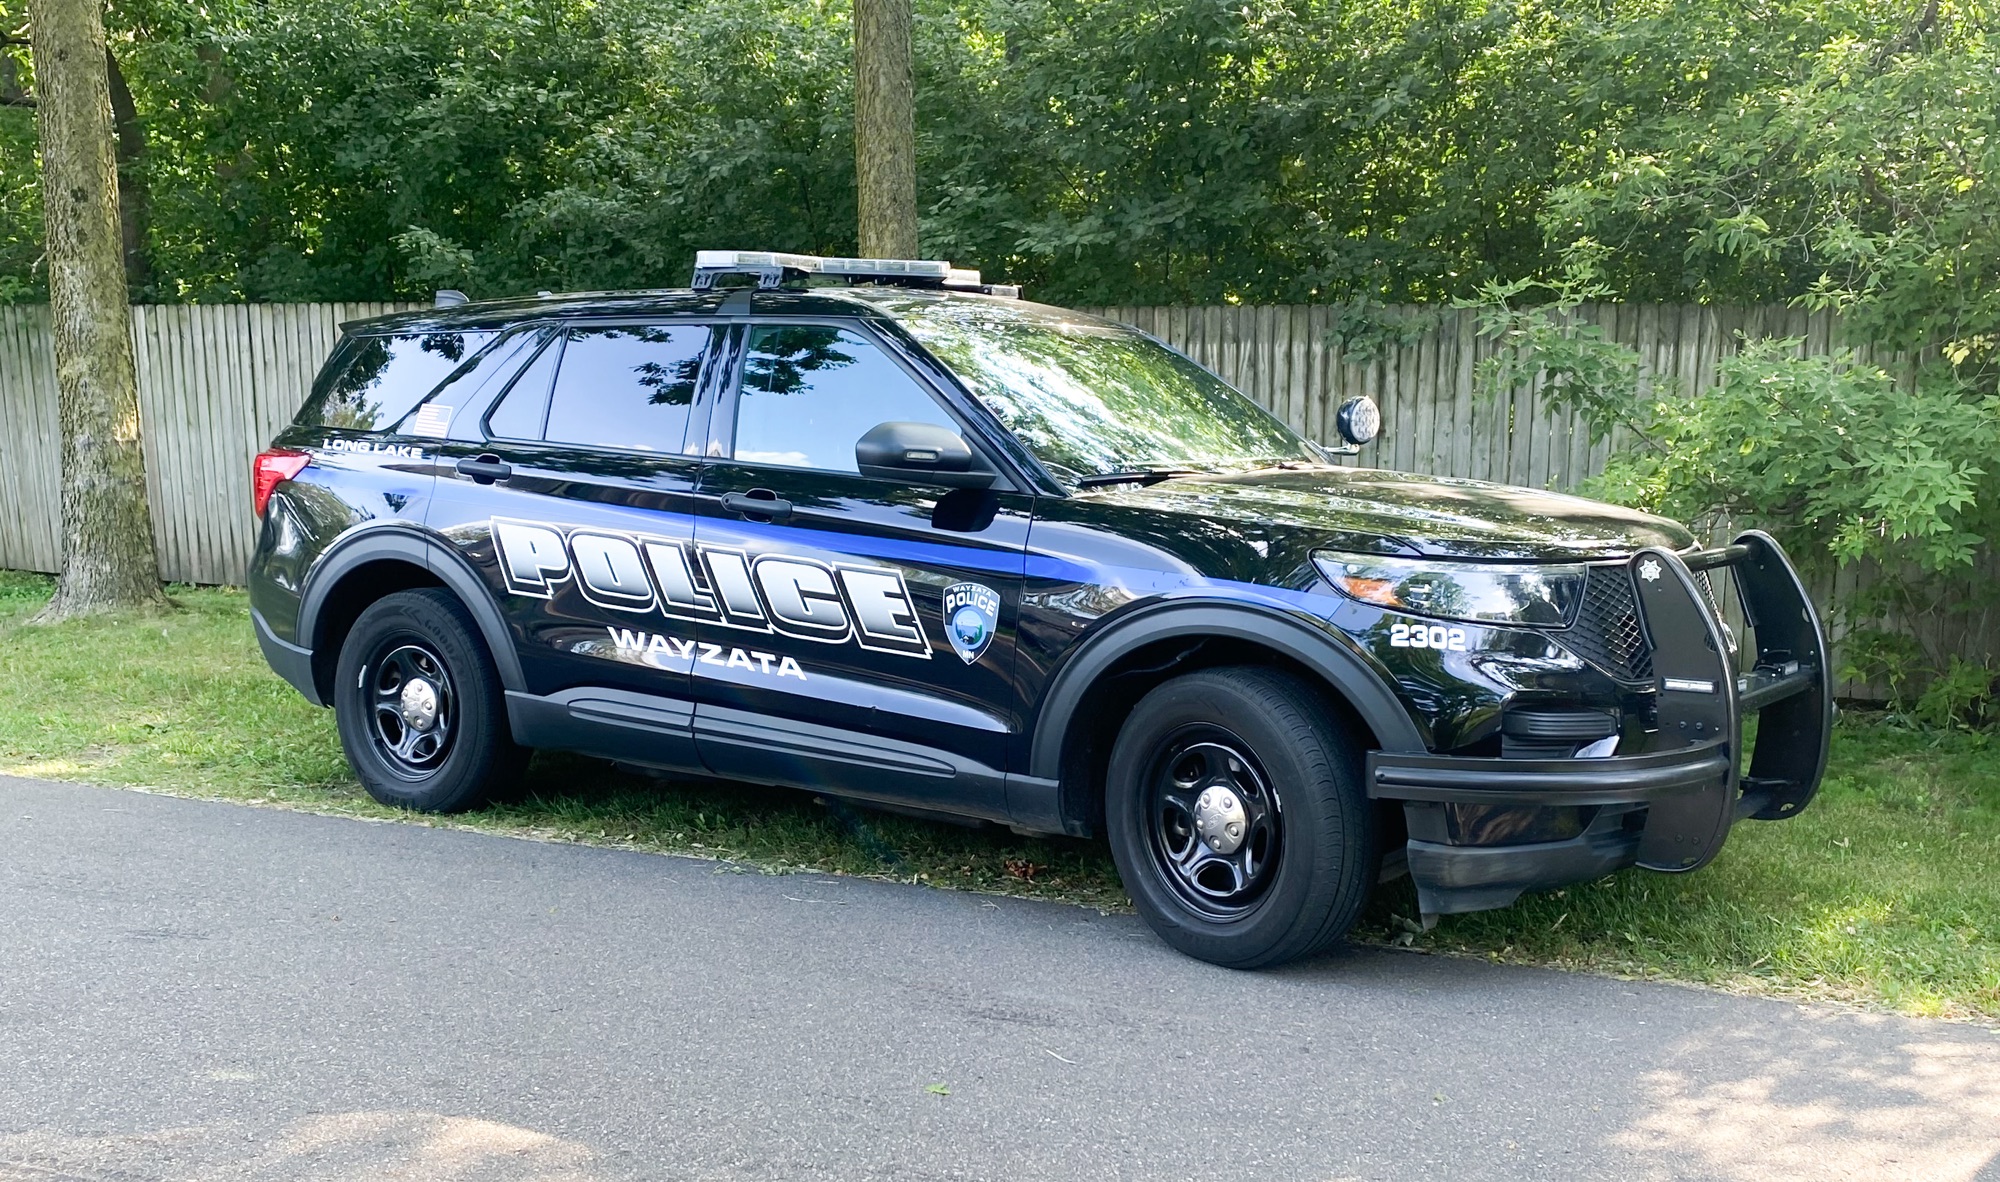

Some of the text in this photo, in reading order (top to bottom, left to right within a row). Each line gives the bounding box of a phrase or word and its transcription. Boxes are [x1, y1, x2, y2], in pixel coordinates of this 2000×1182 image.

[322, 438, 424, 460] LONG LAKE
[488, 515, 934, 660] POLICE
[952, 585, 991, 597] WAYZATA
[945, 591, 997, 617] POLICE
[1390, 623, 1466, 652] 2302
[606, 625, 808, 681] WAYZATA
[962, 650, 975, 660] MN
